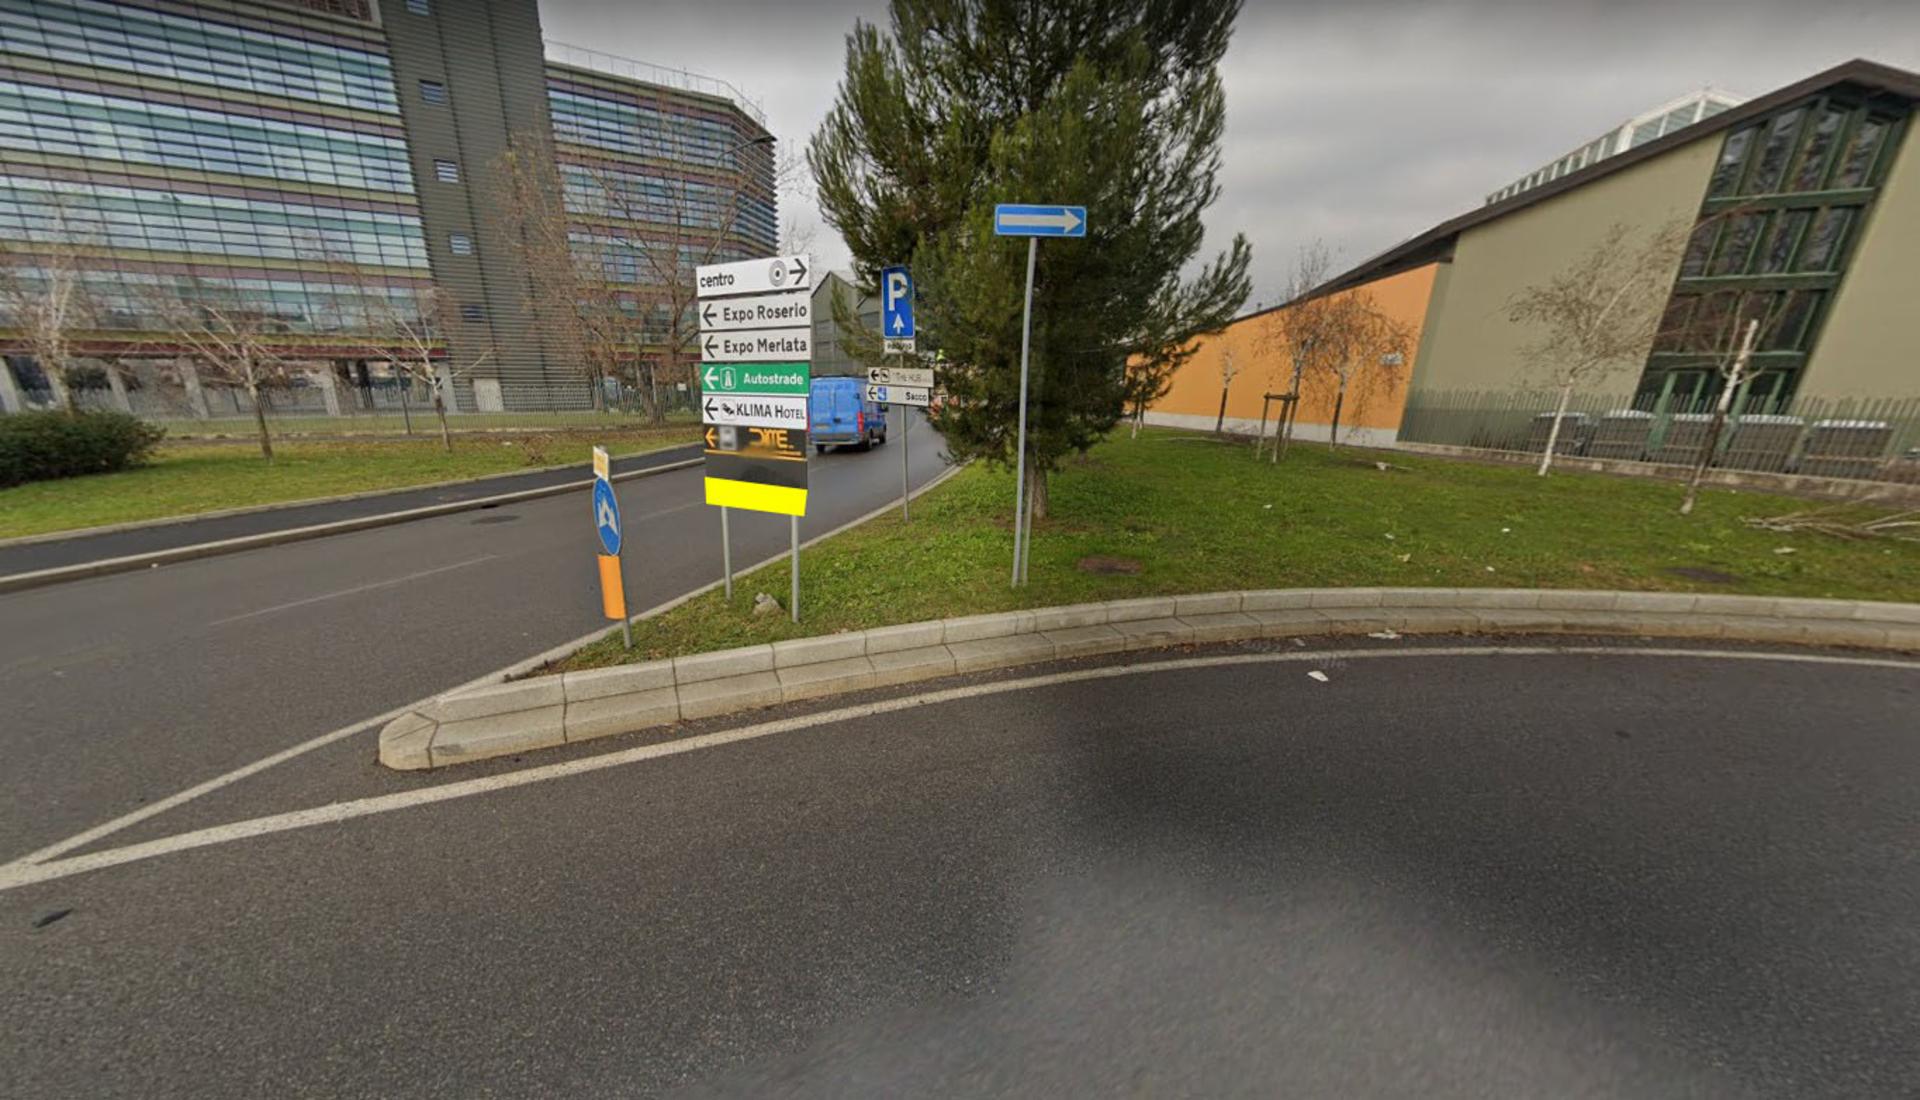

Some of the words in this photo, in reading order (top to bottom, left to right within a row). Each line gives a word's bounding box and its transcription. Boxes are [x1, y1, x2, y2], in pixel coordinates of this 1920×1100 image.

[700, 273, 735, 288] centro
[888, 272, 908, 311] P
[723, 307, 754, 323] Expo
[757, 302, 807, 320] Roserio
[724, 340, 754, 355] Expo
[757, 338, 807, 354] Merlata
[743, 372, 804, 385] Autostrade
[736, 403, 772, 418] KLIMA
[775, 405, 805, 420] HOTEL
